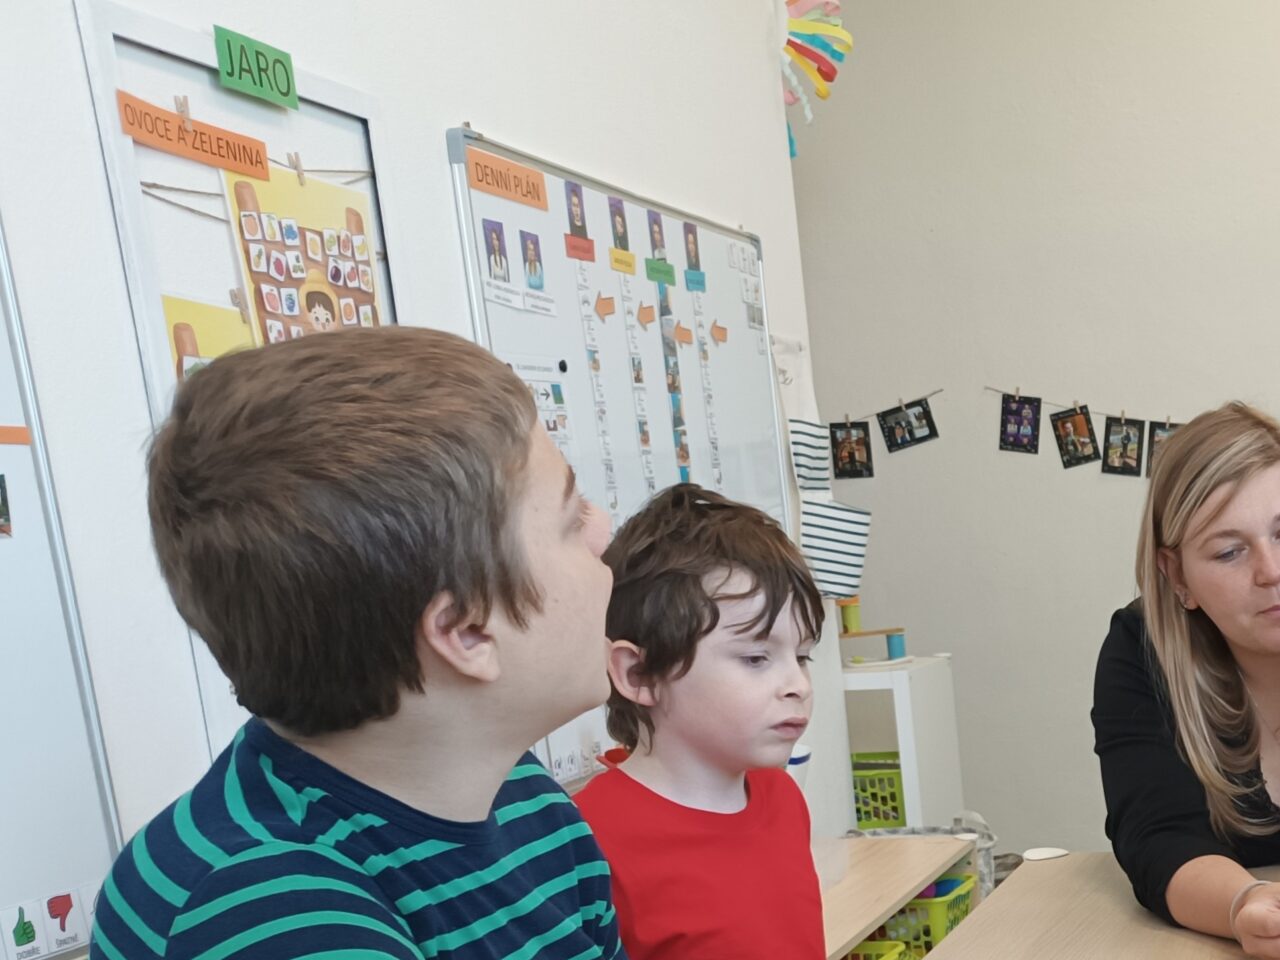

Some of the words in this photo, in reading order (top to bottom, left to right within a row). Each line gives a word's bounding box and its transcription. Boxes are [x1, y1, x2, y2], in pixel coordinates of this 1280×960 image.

[226, 39, 291, 98] JARO
[123, 103, 173, 142] OVOCE
[177, 124, 188, 147] A
[191, 129, 265, 170] ZELENINA
[475, 162, 512, 192] DENNÍ
[513, 174, 541, 202] PLÁN
